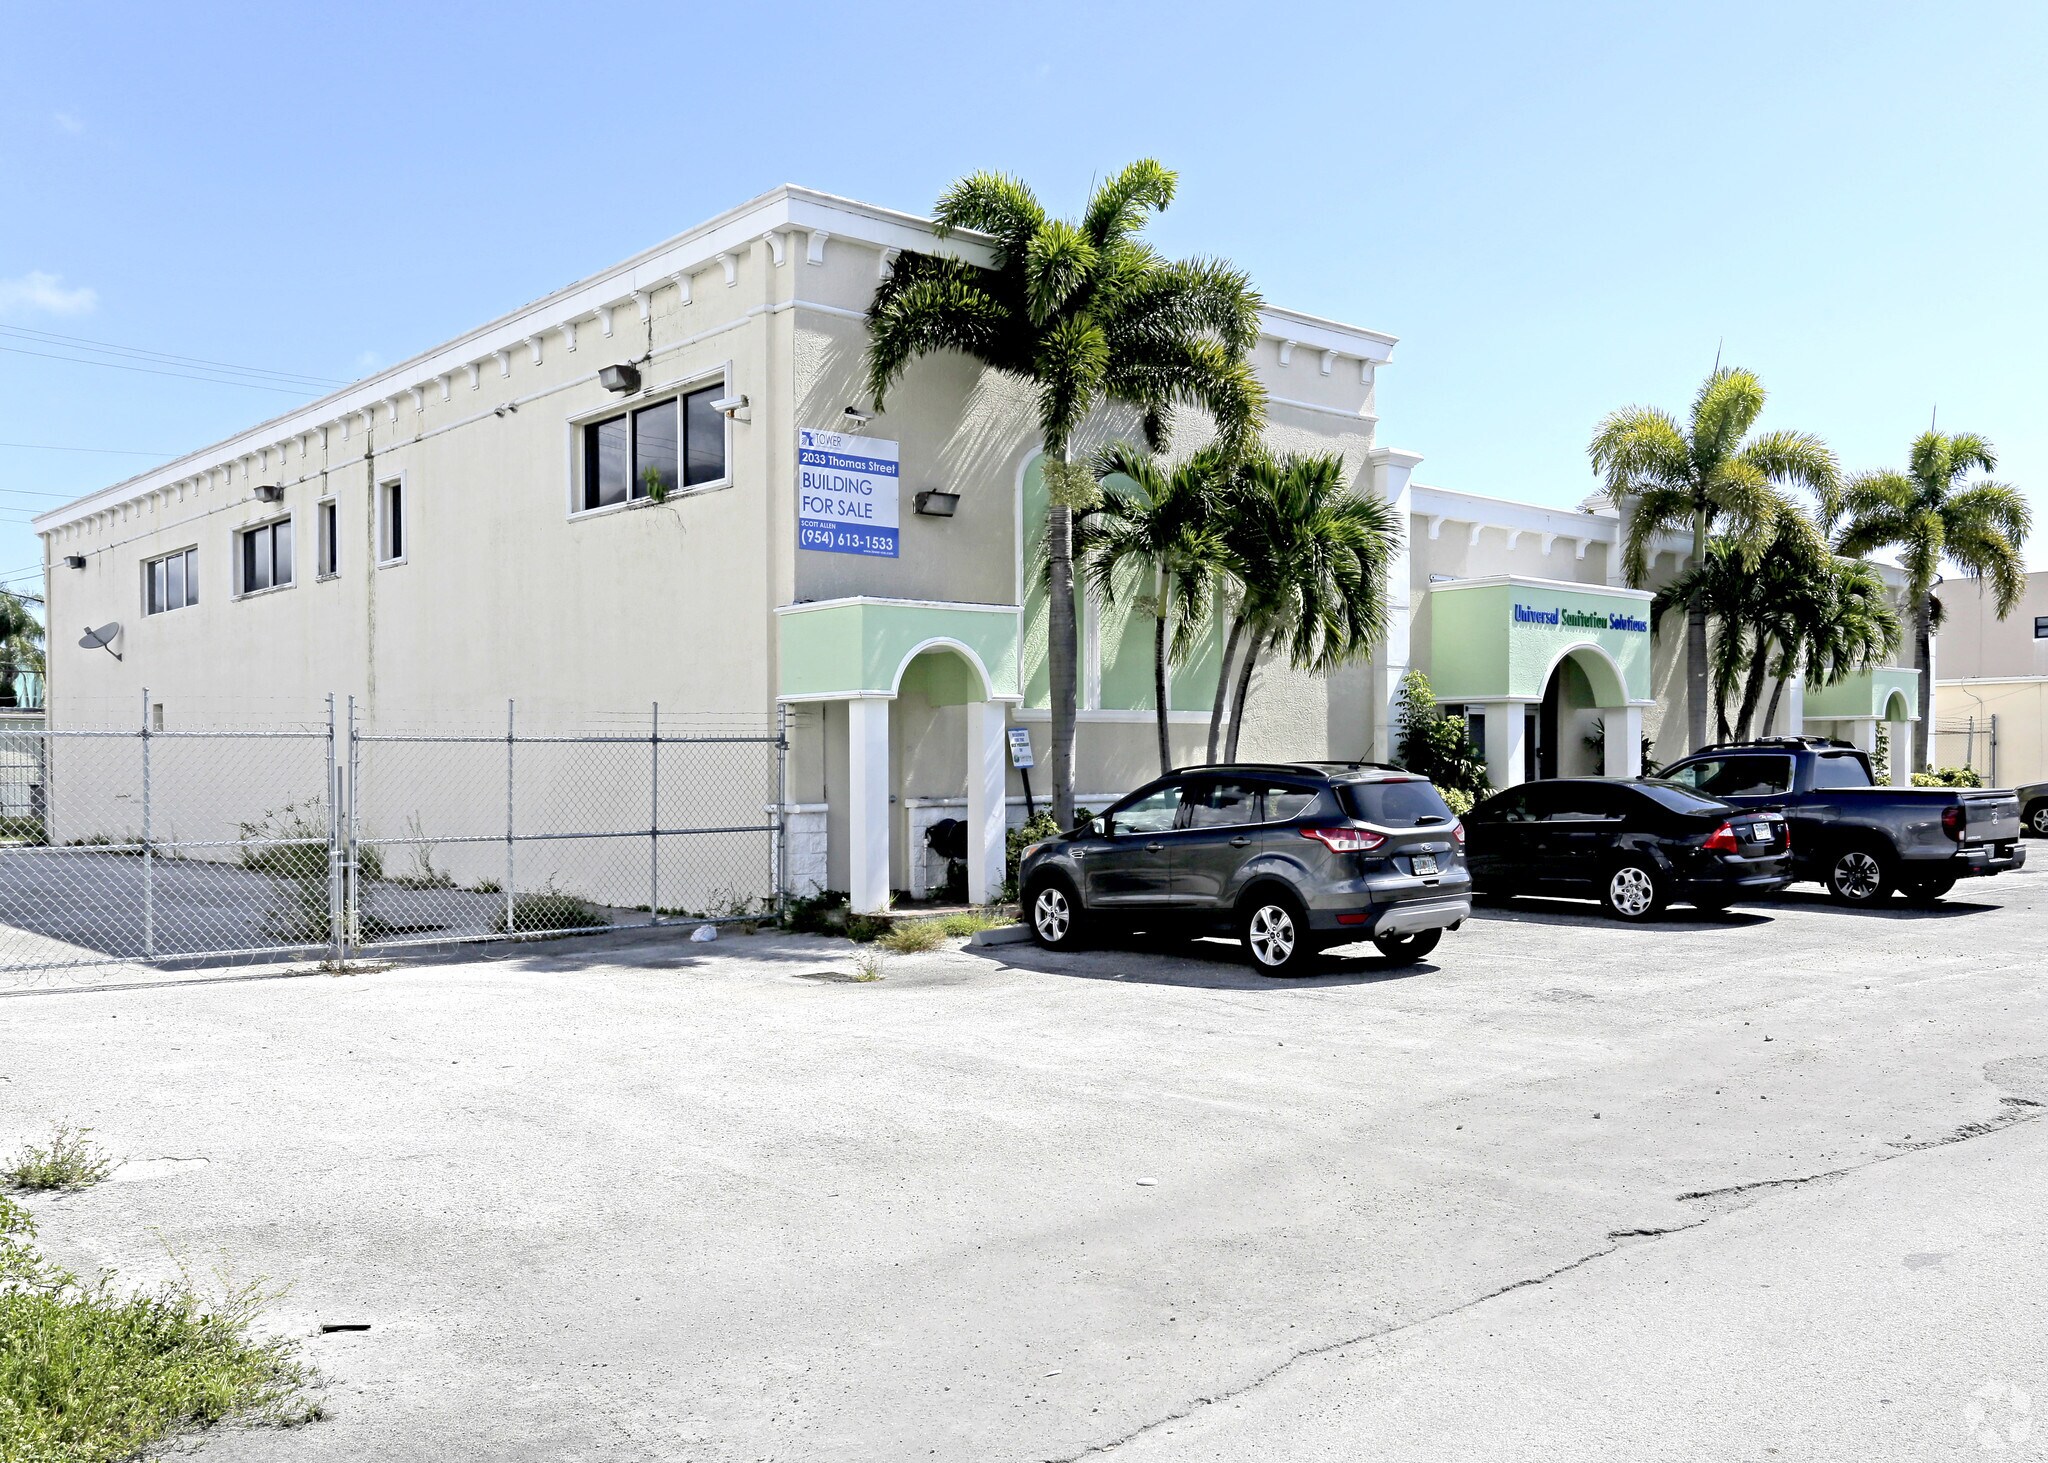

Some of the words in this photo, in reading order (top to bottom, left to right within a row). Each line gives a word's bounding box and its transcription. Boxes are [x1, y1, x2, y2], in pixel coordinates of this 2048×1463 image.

[816, 433, 841, 446] TOWER
[802, 452, 826, 465] 2033
[828, 455, 866, 470] Thomas
[868, 461, 896, 474] Street
[803, 472, 873, 496] BUILDING
[803, 496, 833, 514] FOR
[837, 499, 873, 519] SALE
[801, 520, 818, 528] SCOTT
[802, 529, 834, 547] (954)
[838, 533, 893, 550] 613-1533
[1514, 603, 1559, 625] Universal
[1561, 608, 1608, 629] Sanitation
[1609, 613, 1647, 632] Solutions
